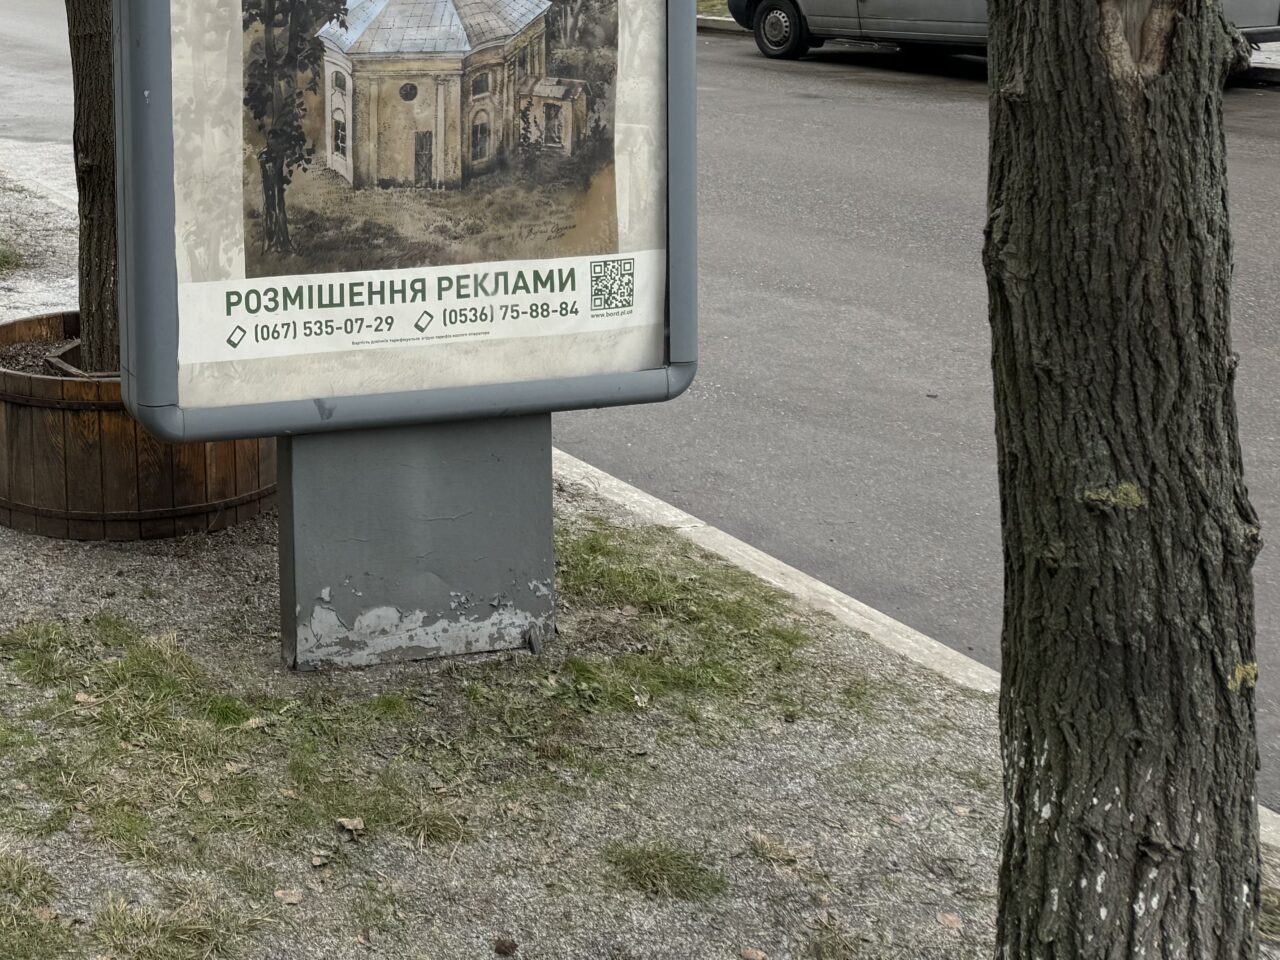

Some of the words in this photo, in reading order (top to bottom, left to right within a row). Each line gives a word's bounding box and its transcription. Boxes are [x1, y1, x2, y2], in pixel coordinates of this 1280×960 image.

[437, 267, 576, 301] РЕКЛАМИ
[442, 304, 494, 327] (0536)
[500, 301, 579, 321] 75-88-84
[254, 321, 297, 343] (067)
[303, 315, 395, 337] 535-07-29
